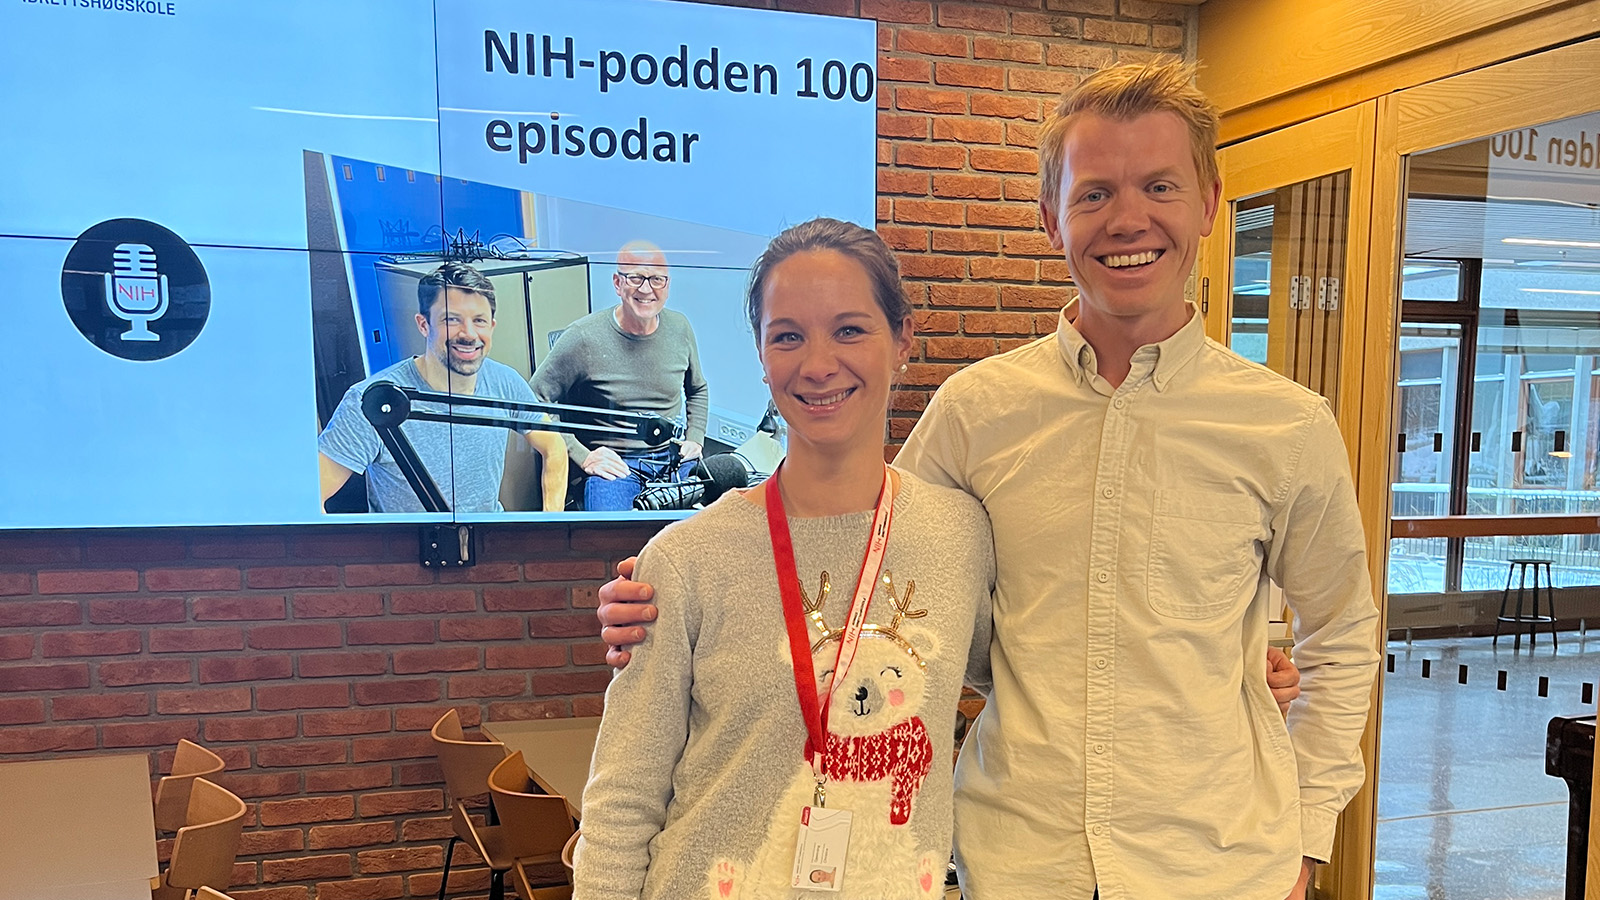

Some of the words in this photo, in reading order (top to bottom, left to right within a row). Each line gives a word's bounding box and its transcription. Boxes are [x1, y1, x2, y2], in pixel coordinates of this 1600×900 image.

[22, 0, 176, 16] TSHØGSKOLE
[484, 29, 778, 95] NIH-podden
[796, 57, 874, 103] 100
[485, 111, 699, 164] episodar
[118, 283, 155, 301] NIH
